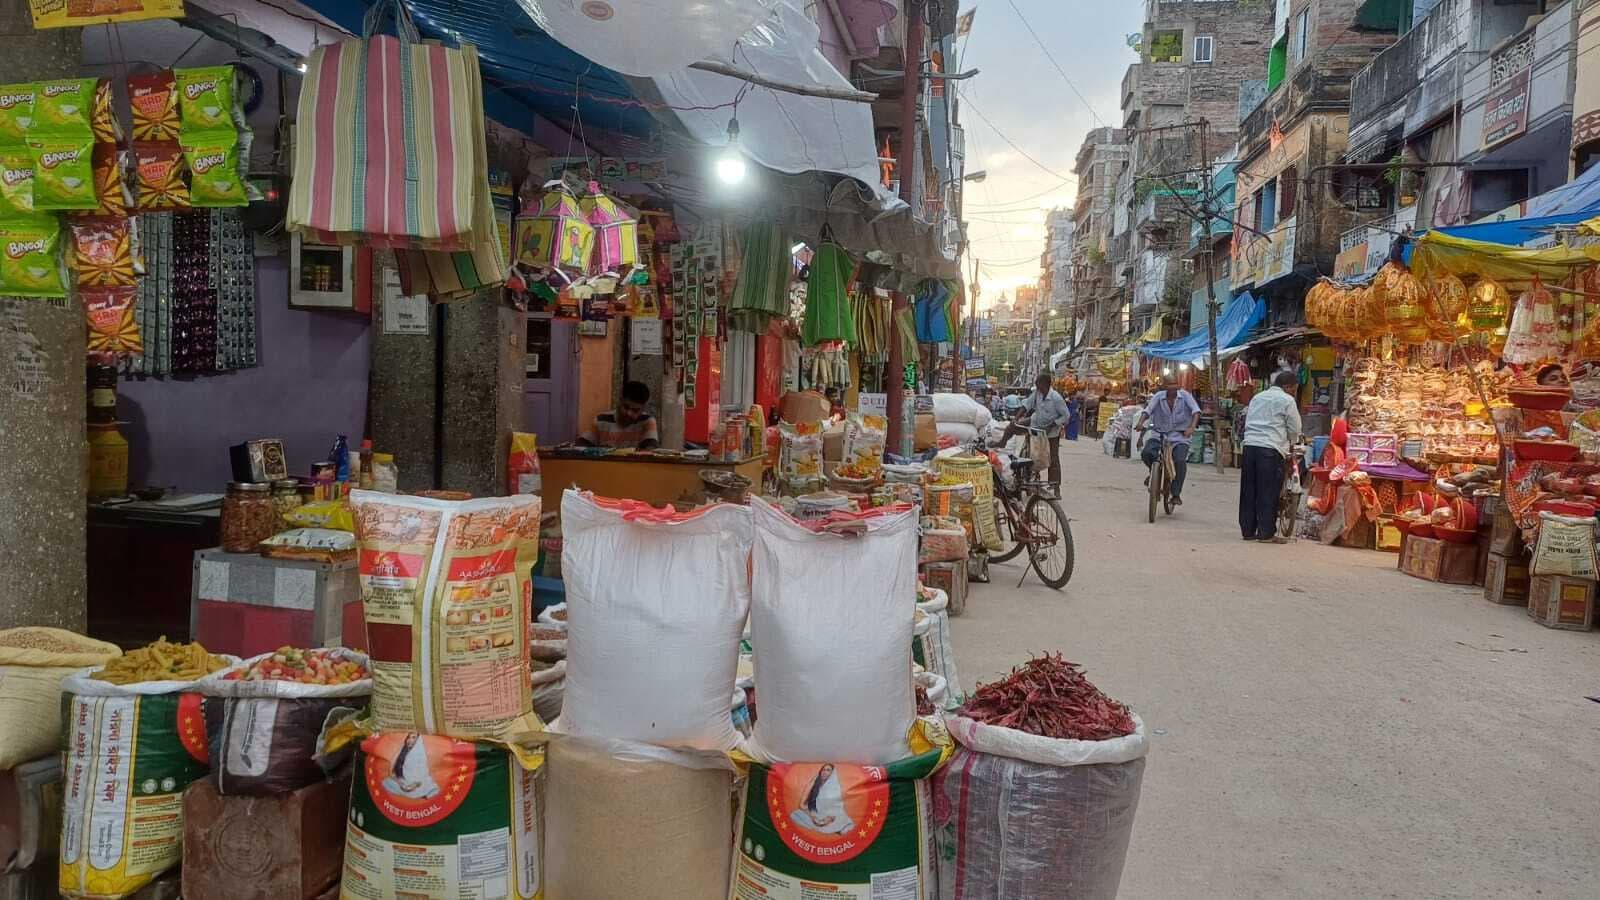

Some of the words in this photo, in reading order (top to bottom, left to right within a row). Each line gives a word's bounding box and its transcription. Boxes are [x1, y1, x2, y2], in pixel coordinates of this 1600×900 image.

[42, 151, 80, 165] BINGO!
[195, 152, 225, 169] BINGO!
[3, 169, 34, 181] BING
[9, 240, 48, 253] BINGO!
[383, 799, 405, 817] WEST
[405, 803, 442, 819] BENGAL
[791, 832, 816, 854] WEST
[817, 840, 855, 856] BENGAL
